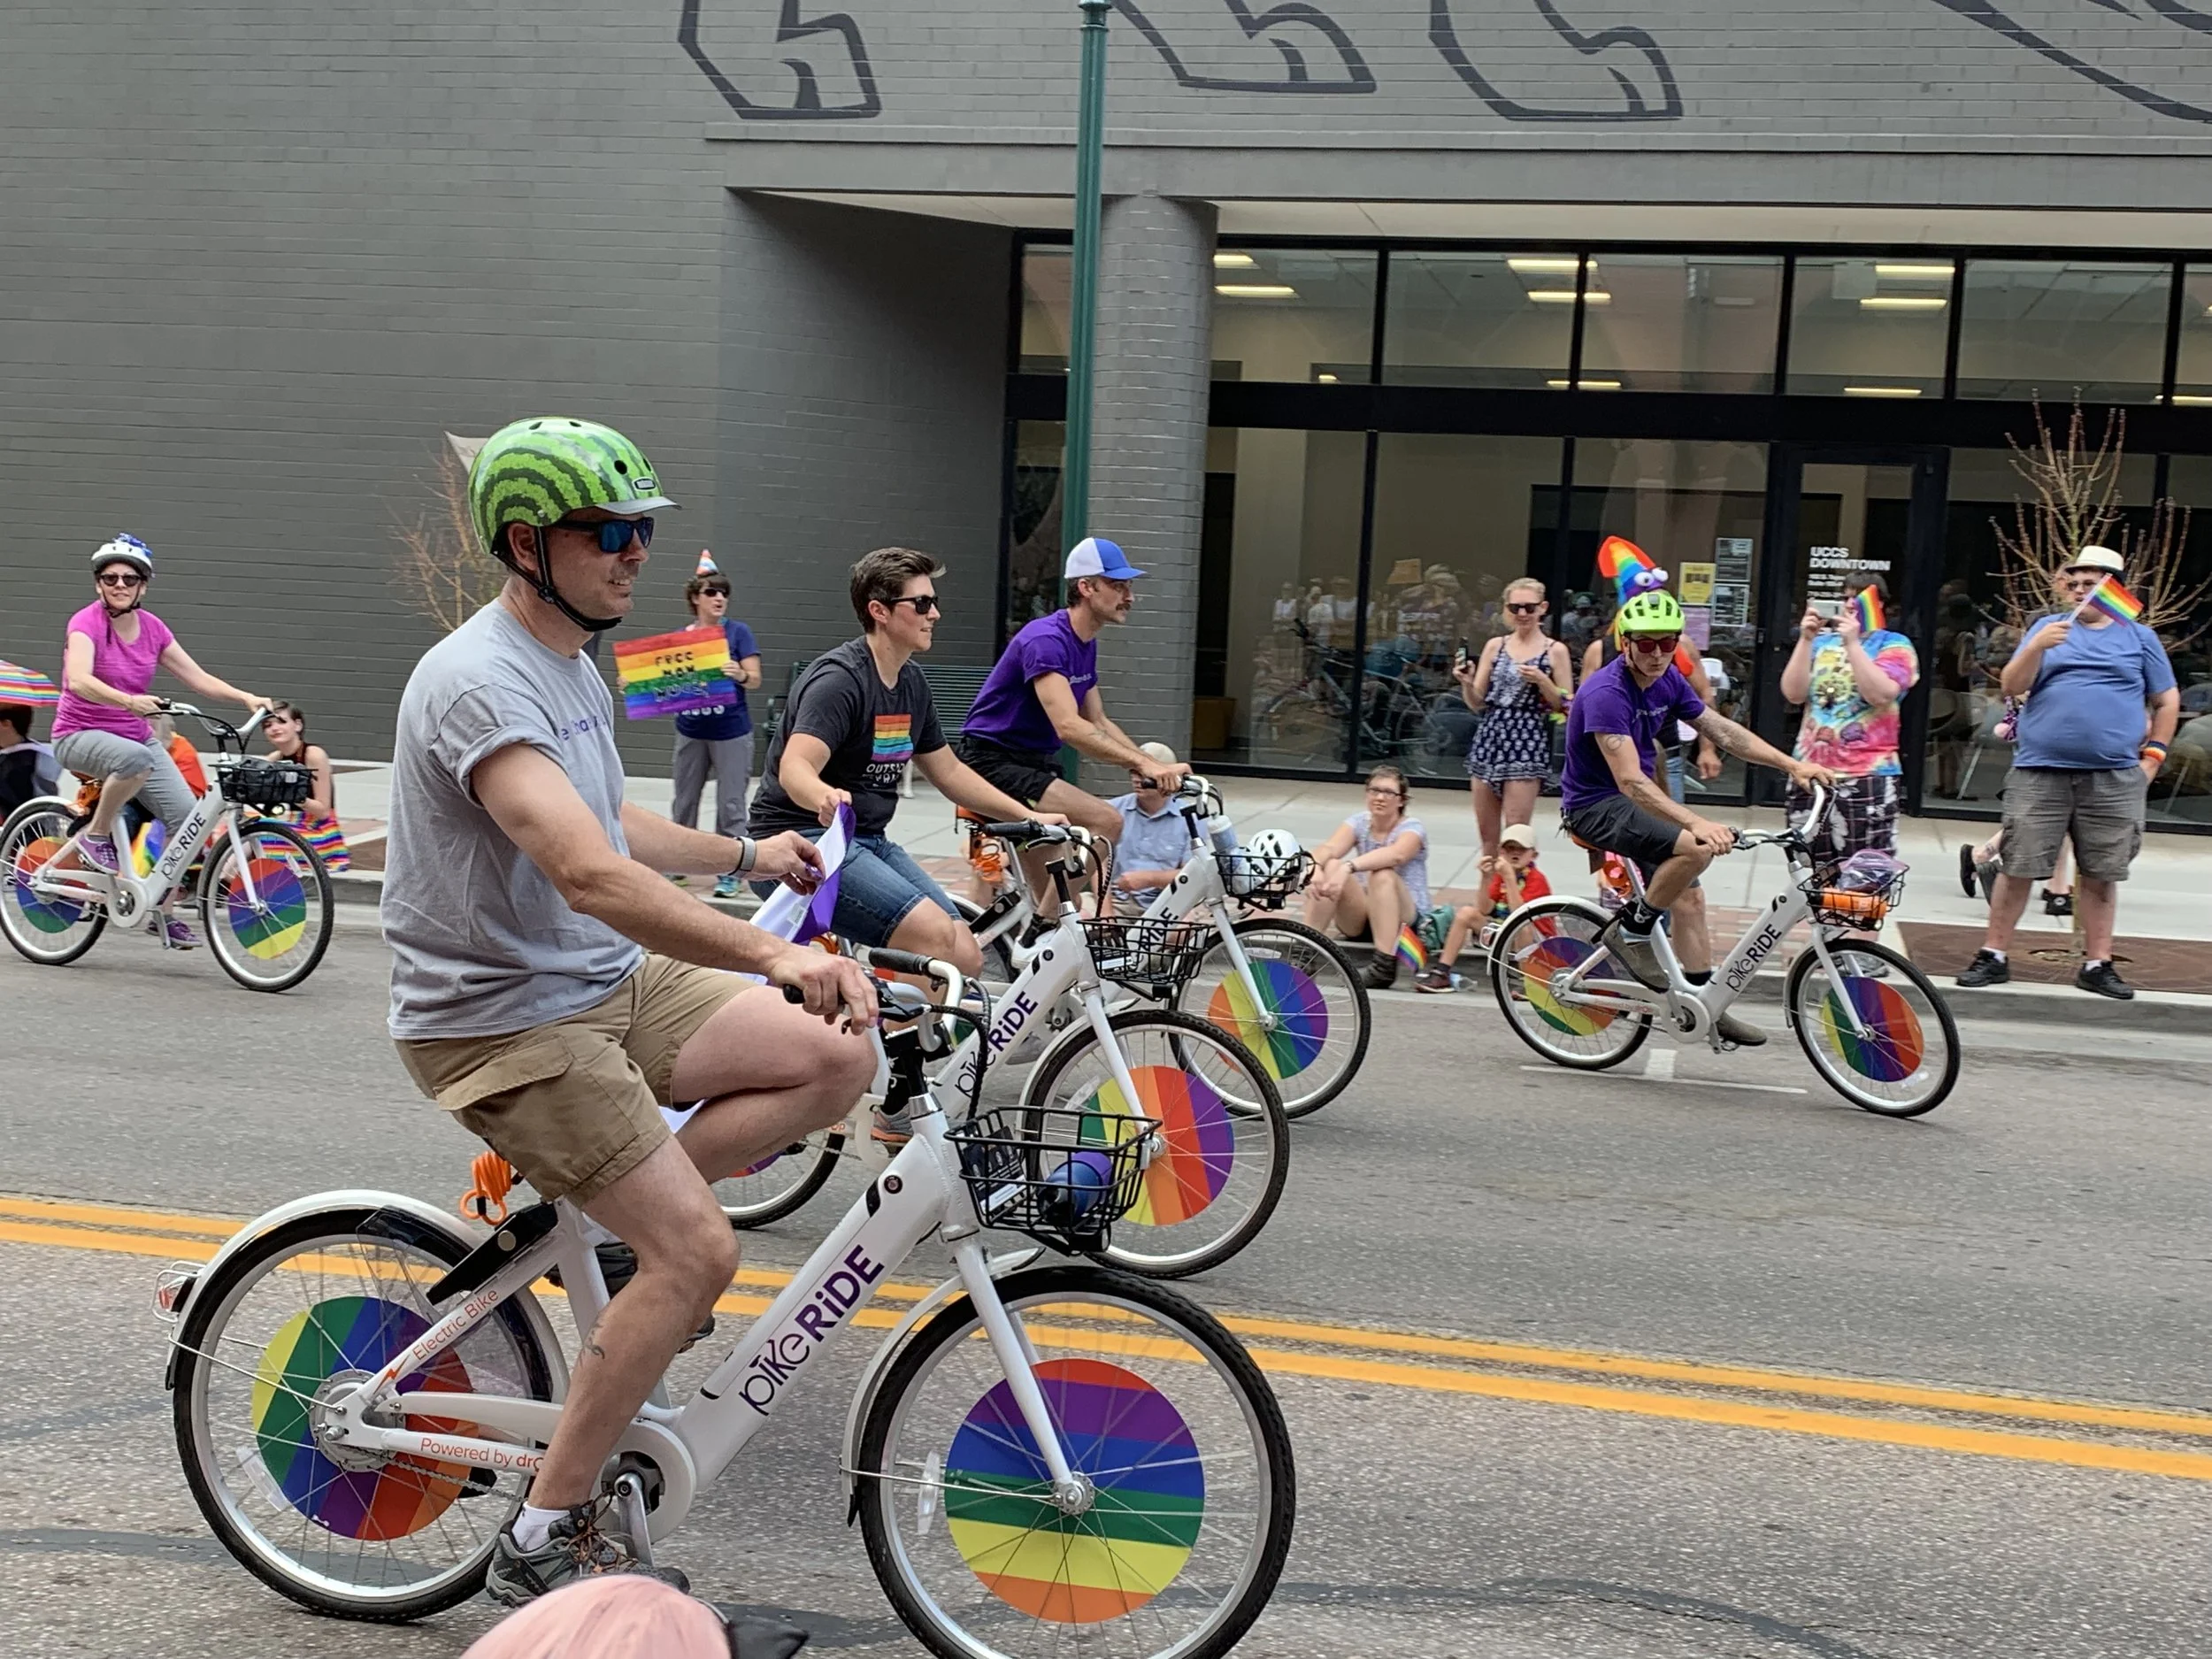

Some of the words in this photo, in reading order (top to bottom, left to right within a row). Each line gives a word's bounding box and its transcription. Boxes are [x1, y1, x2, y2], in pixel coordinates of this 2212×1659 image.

[1809, 546, 1849, 558] UCCS
[1809, 557, 1892, 571] DOWNTOWN
[412, 1316, 466, 1361] Electric
[464, 1290, 499, 1318] Bike
[420, 1437, 490, 1462] Powered
[494, 1448, 513, 1468] by
